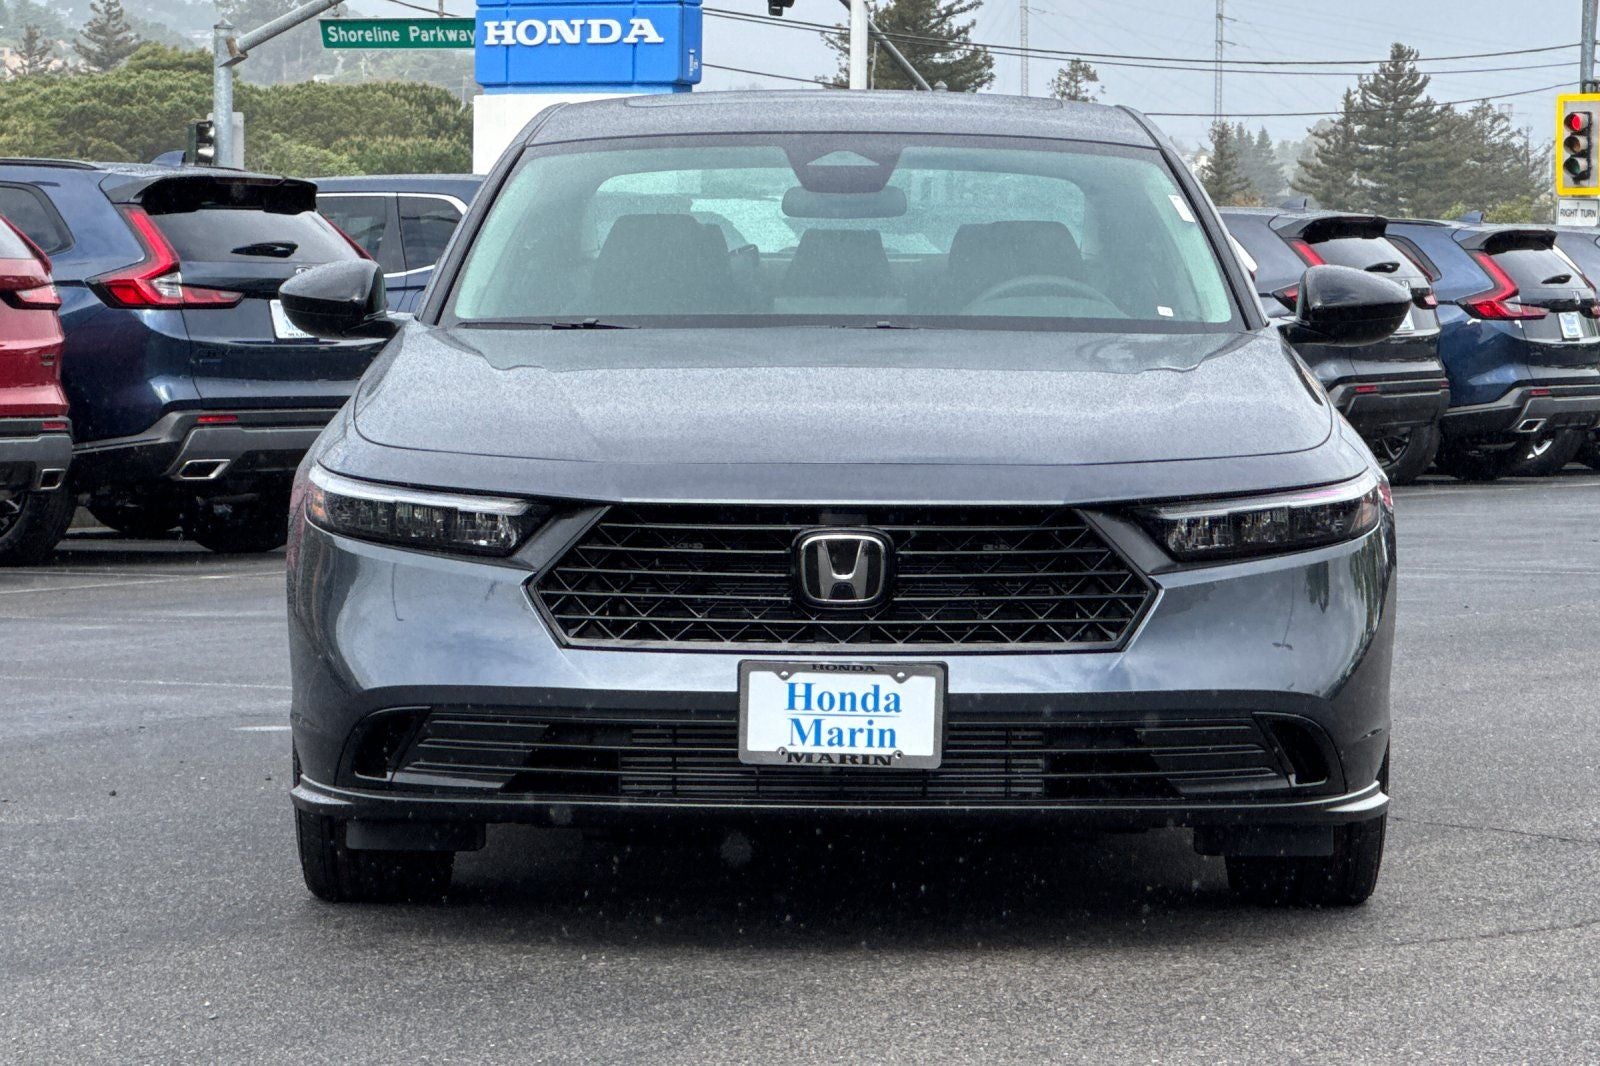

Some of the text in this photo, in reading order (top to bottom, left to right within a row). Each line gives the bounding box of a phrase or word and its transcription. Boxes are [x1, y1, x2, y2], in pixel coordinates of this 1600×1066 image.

[327, 25, 475, 45] Shoreline Parkway
[484, 18, 664, 46] HONDA
[1560, 208, 1597, 217] RIGHT TURN
[811, 663, 877, 673] HONDA
[784, 682, 902, 713] Honda
[787, 717, 897, 749] Marin
[786, 752, 893, 766] MARIN
